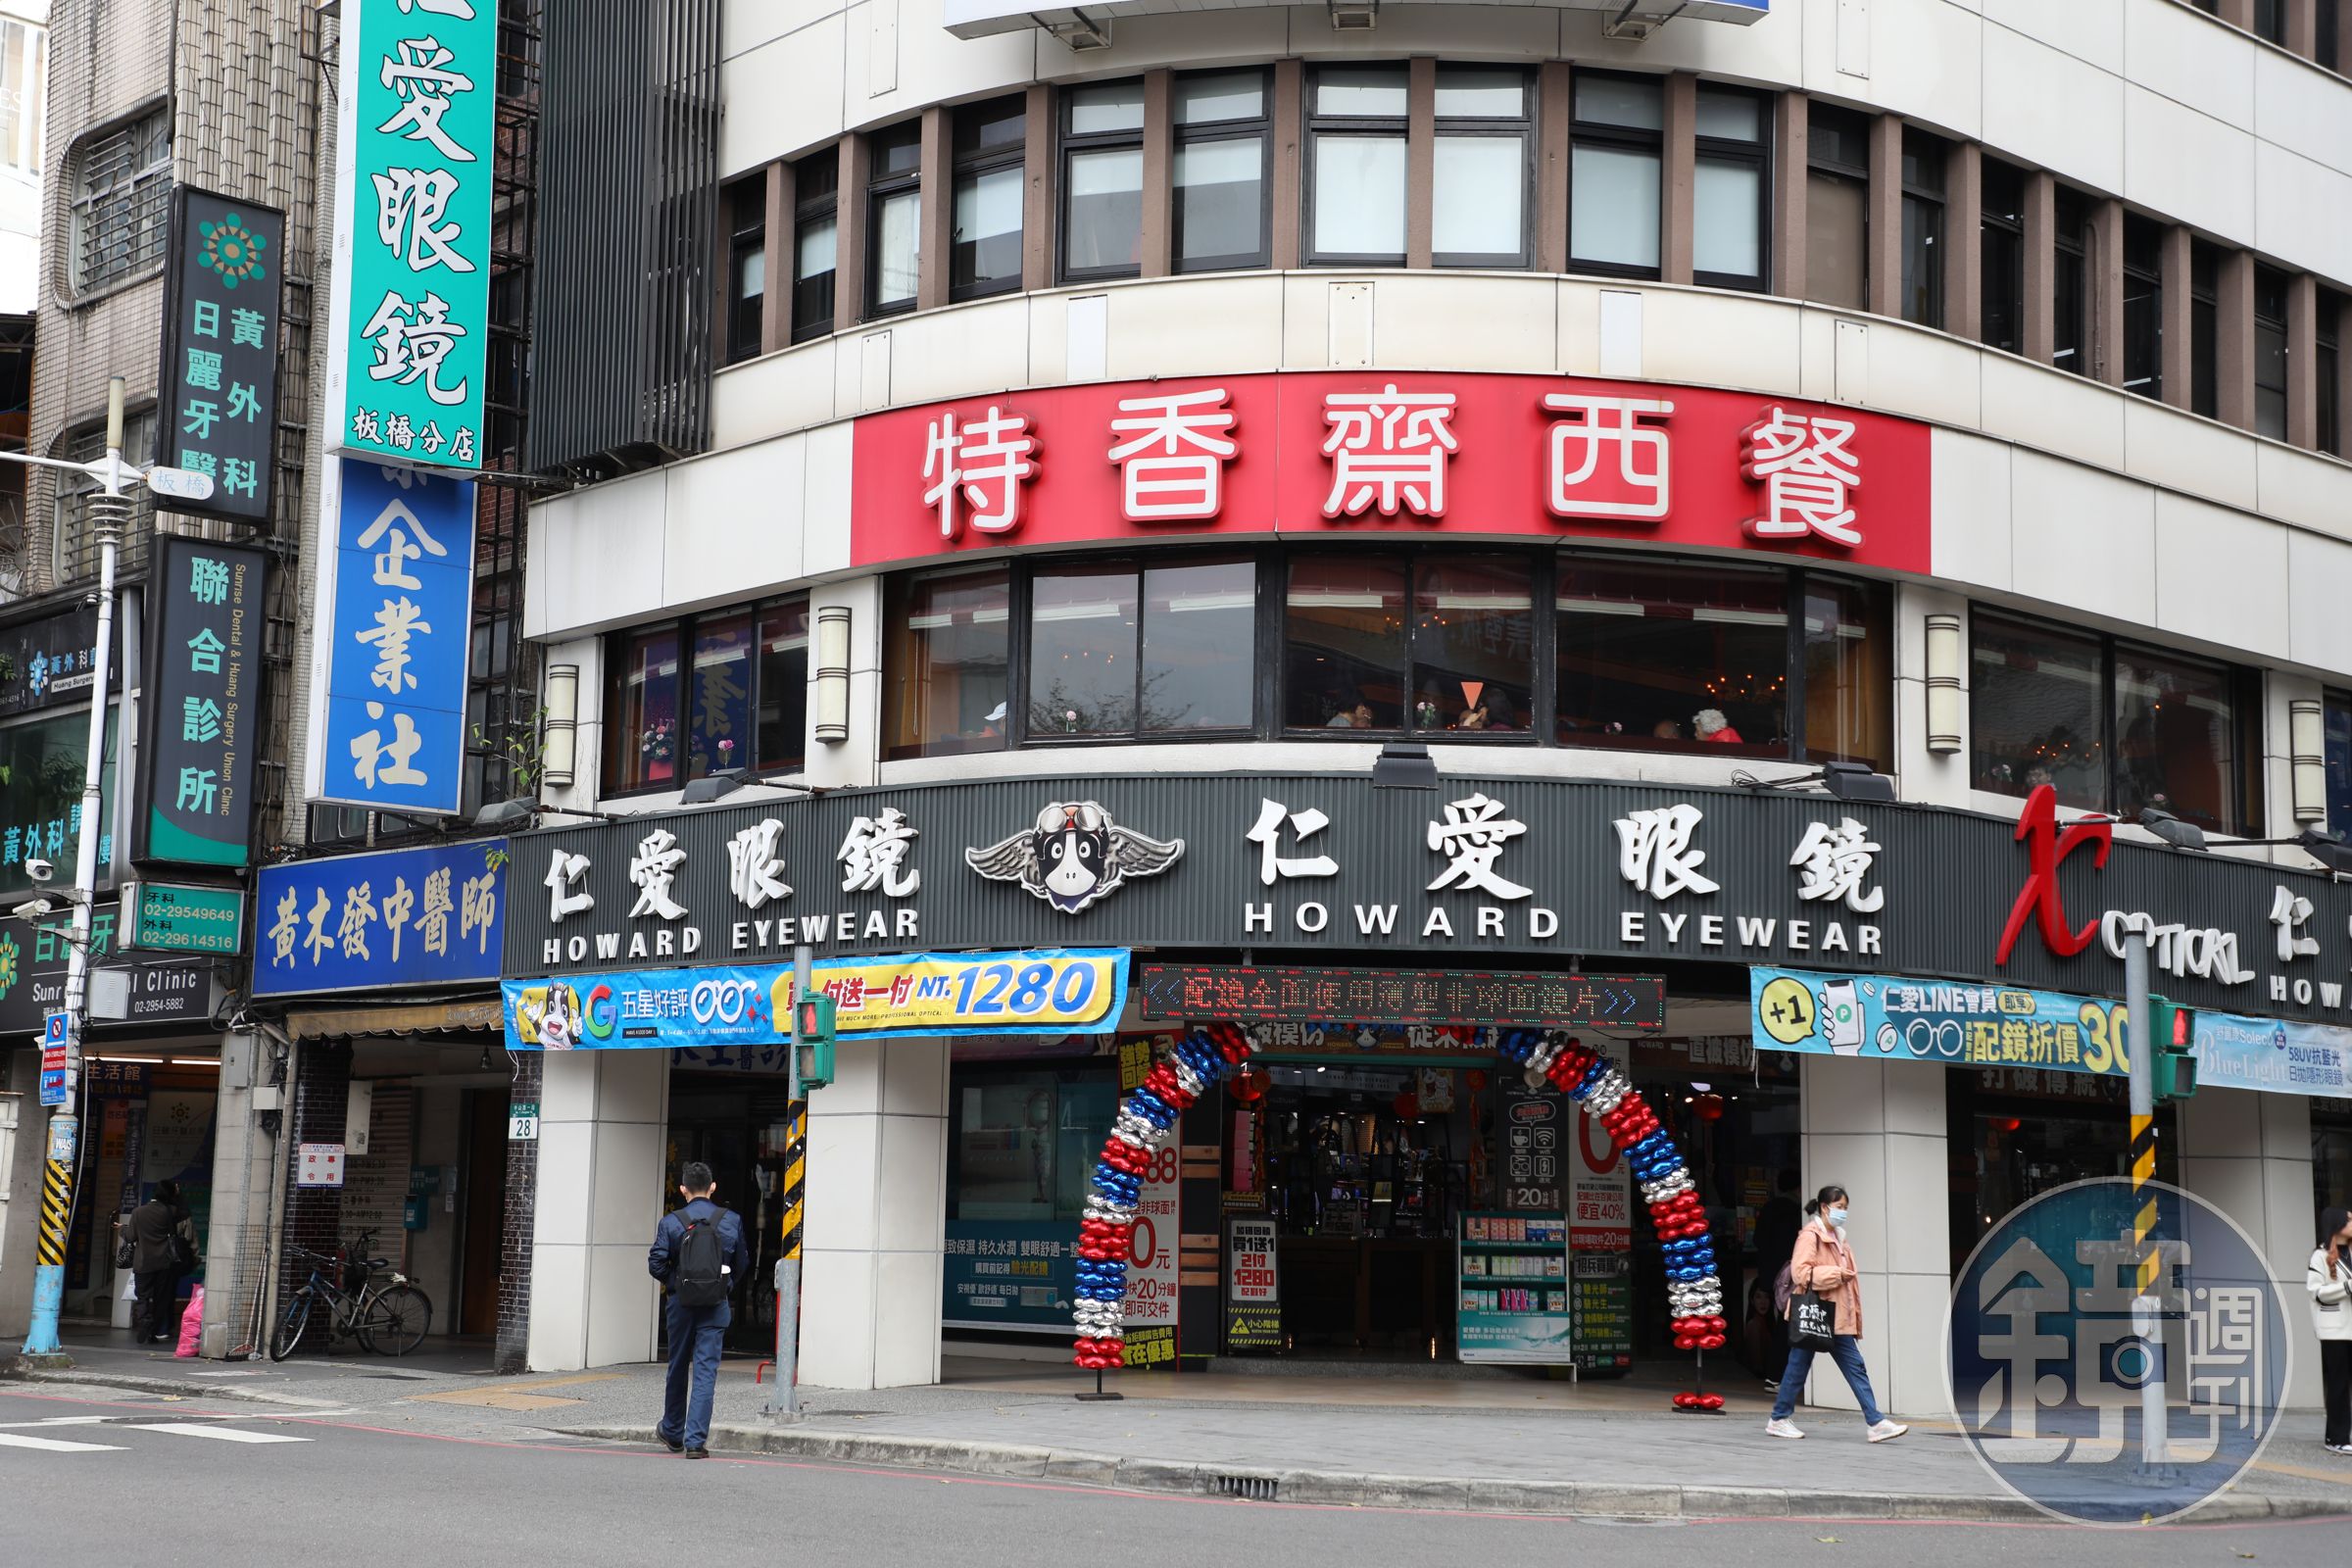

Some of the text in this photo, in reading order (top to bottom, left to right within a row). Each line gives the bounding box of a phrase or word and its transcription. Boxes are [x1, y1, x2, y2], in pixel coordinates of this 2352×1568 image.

[362, 0, 478, 407] 愛眼鏡
[223, 309, 267, 499] 黃外科
[351, 407, 475, 463] 板橋分店
[920, 380, 1865, 550] 特香齋西餐
[156, 470, 205, 496] 板橋
[176, 557, 229, 814] 聯合診所
[221, 564, 246, 817] Sunrise Dental & Huang Surgery Union Clinic
[3, 818, 64, 866] 黃外科
[1246, 792, 1886, 913] 仁愛眼鏡
[542, 807, 921, 923] 仁愛眼鏡
[144, 904, 235, 922] 02-29549649
[147, 892, 175, 904] 牙科
[143, 919, 172, 931] 外科
[268, 865, 496, 969] 黃木發中醫師
[1244, 902, 1883, 955] HOWARD EYEWEAR
[35, 912, 116, 963] 日麗牙
[142, 931, 233, 949] 02-29614516
[543, 907, 919, 964] HOWARD EYEWEAR
[32, 982, 68, 1003] Sunr
[147, 969, 197, 993] Clinic
[787, 974, 913, 1012] 付送一付
[916, 975, 952, 999] NT.
[955, 960, 1099, 1016] 1280
[1880, 984, 1998, 1014] 仁愛LINE會員
[2270, 975, 2352, 1010] HOW
[134, 998, 184, 1013] 02-2954-5882
[584, 984, 617, 1038] G
[621, 988, 689, 1020] 五星好評
[1770, 995, 1806, 1025] +1
[1973, 1019, 2081, 1064] 配鏡折價
[2289, 1046, 2341, 1067] 58UV抗藍光
[78, 1064, 141, 1081] 生活館
[1983, 1068, 2097, 1097] 打破傳統
[515, 1119, 531, 1137] 28
[1517, 1188, 1542, 1206] 20
[1577, 1202, 1625, 1220] 便宜40%
[978, 1239, 1017, 1256] 持久水潤
[1233, 1236, 1275, 1251] 買1送1
[1241, 1253, 1266, 1267] 2付
[1125, 1300, 1170, 1318] 即可交件
